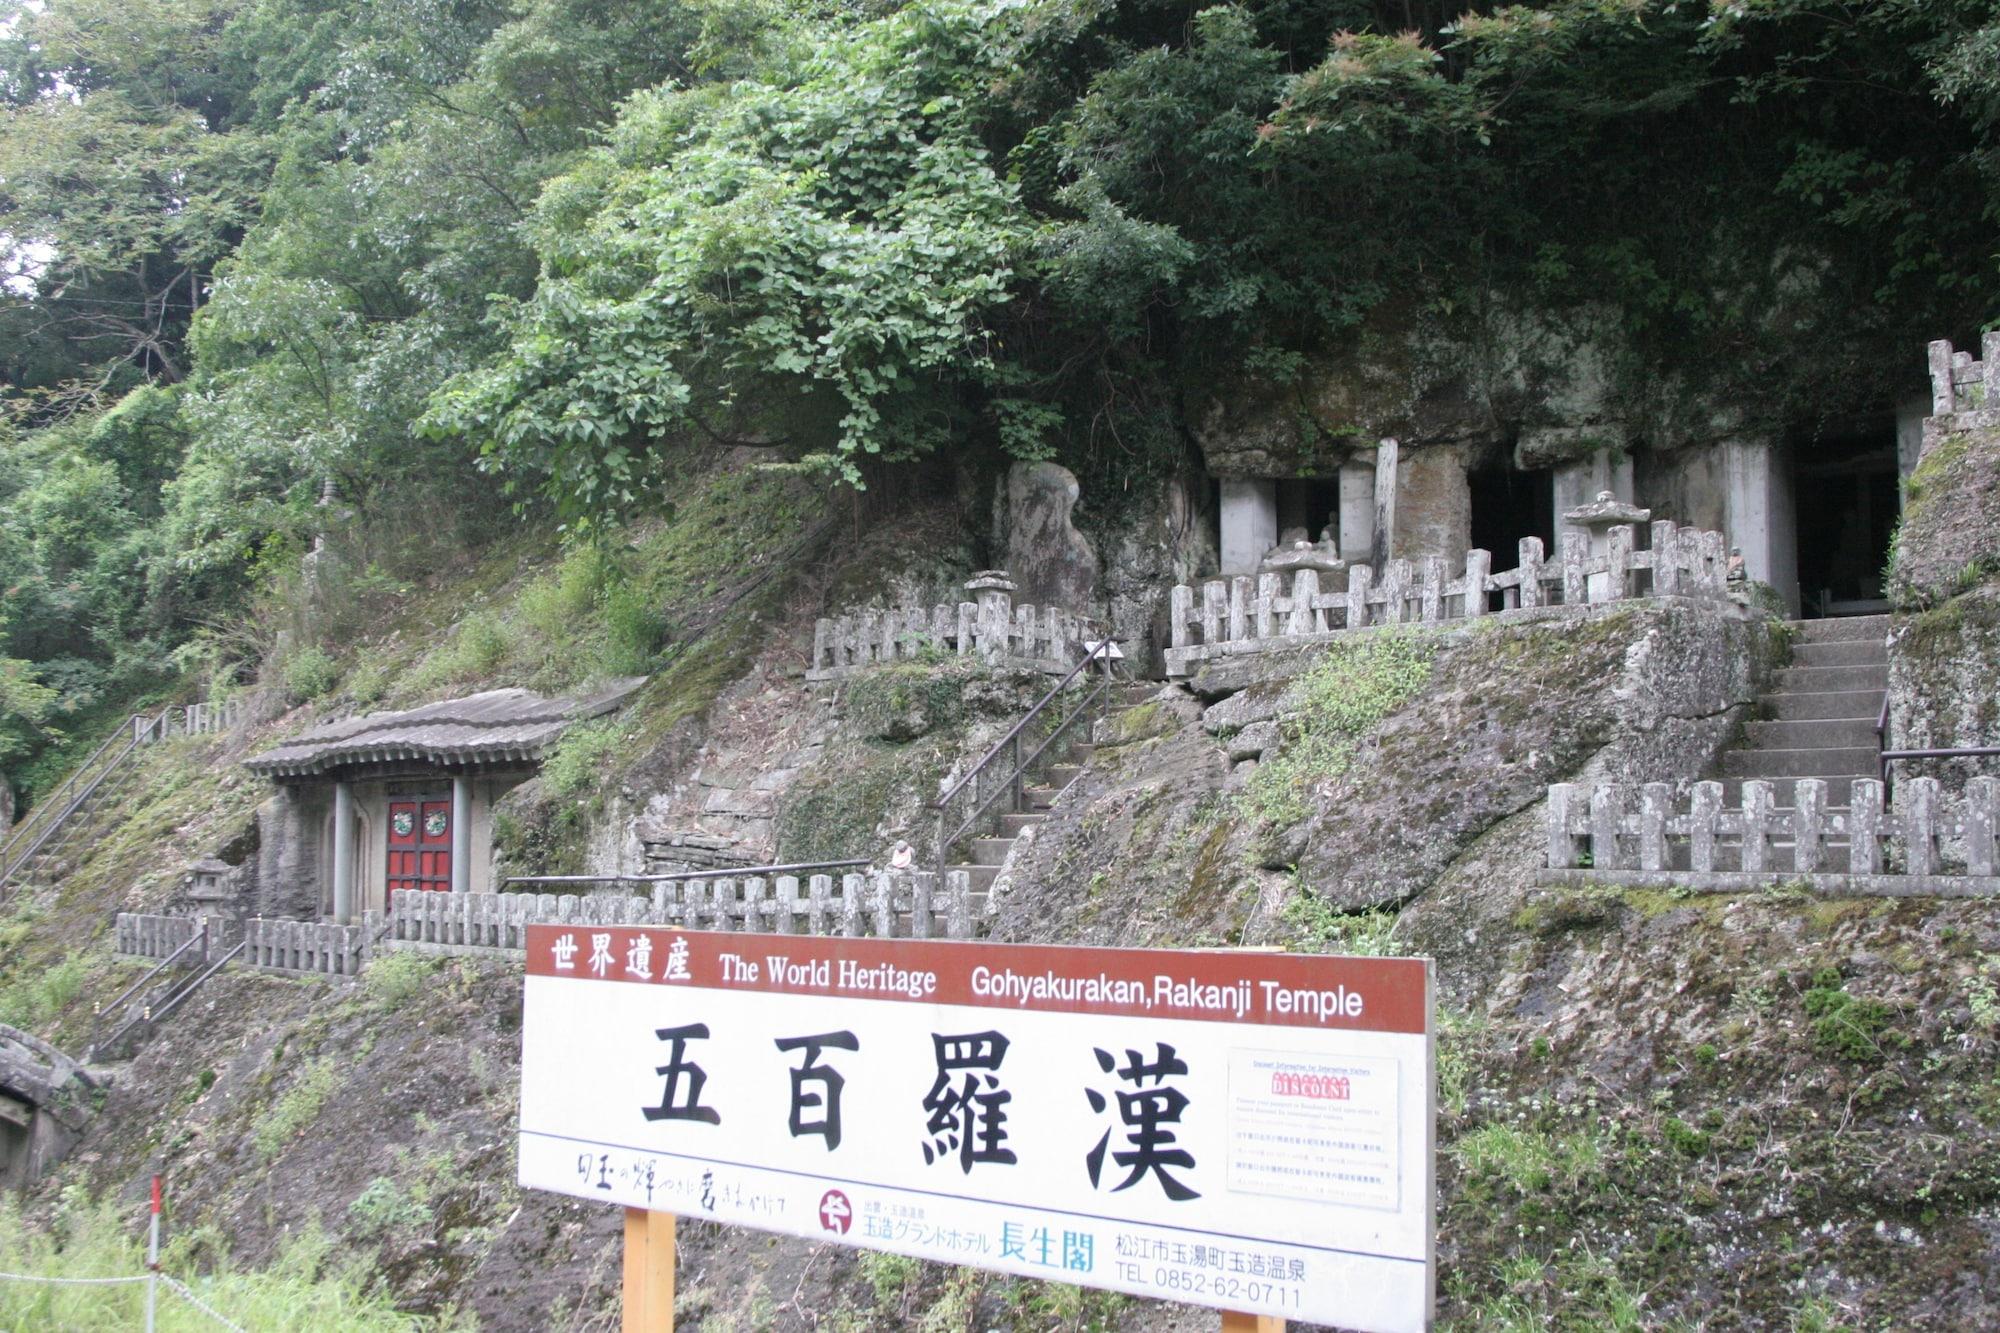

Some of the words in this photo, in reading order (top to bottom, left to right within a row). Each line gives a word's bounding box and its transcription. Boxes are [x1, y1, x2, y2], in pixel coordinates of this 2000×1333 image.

[551, 933, 692, 980] 世界遺産
[719, 953, 759, 982] The
[766, 956, 830, 987] World
[837, 960, 936, 997] Heritage
[1260, 980, 1363, 1022] Temple
[1272, 1076, 1350, 1099] DISCOUNT
[641, 1022, 1202, 1202] 五百羅漢
[998, 1220, 1094, 1273] 長生閣
[1115, 1232, 1307, 1284] 松江市玉湯町玉造温泉
[1115, 1261, 1148, 1284] TEL
[1155, 1268, 1301, 1309] 0852-62-0711
